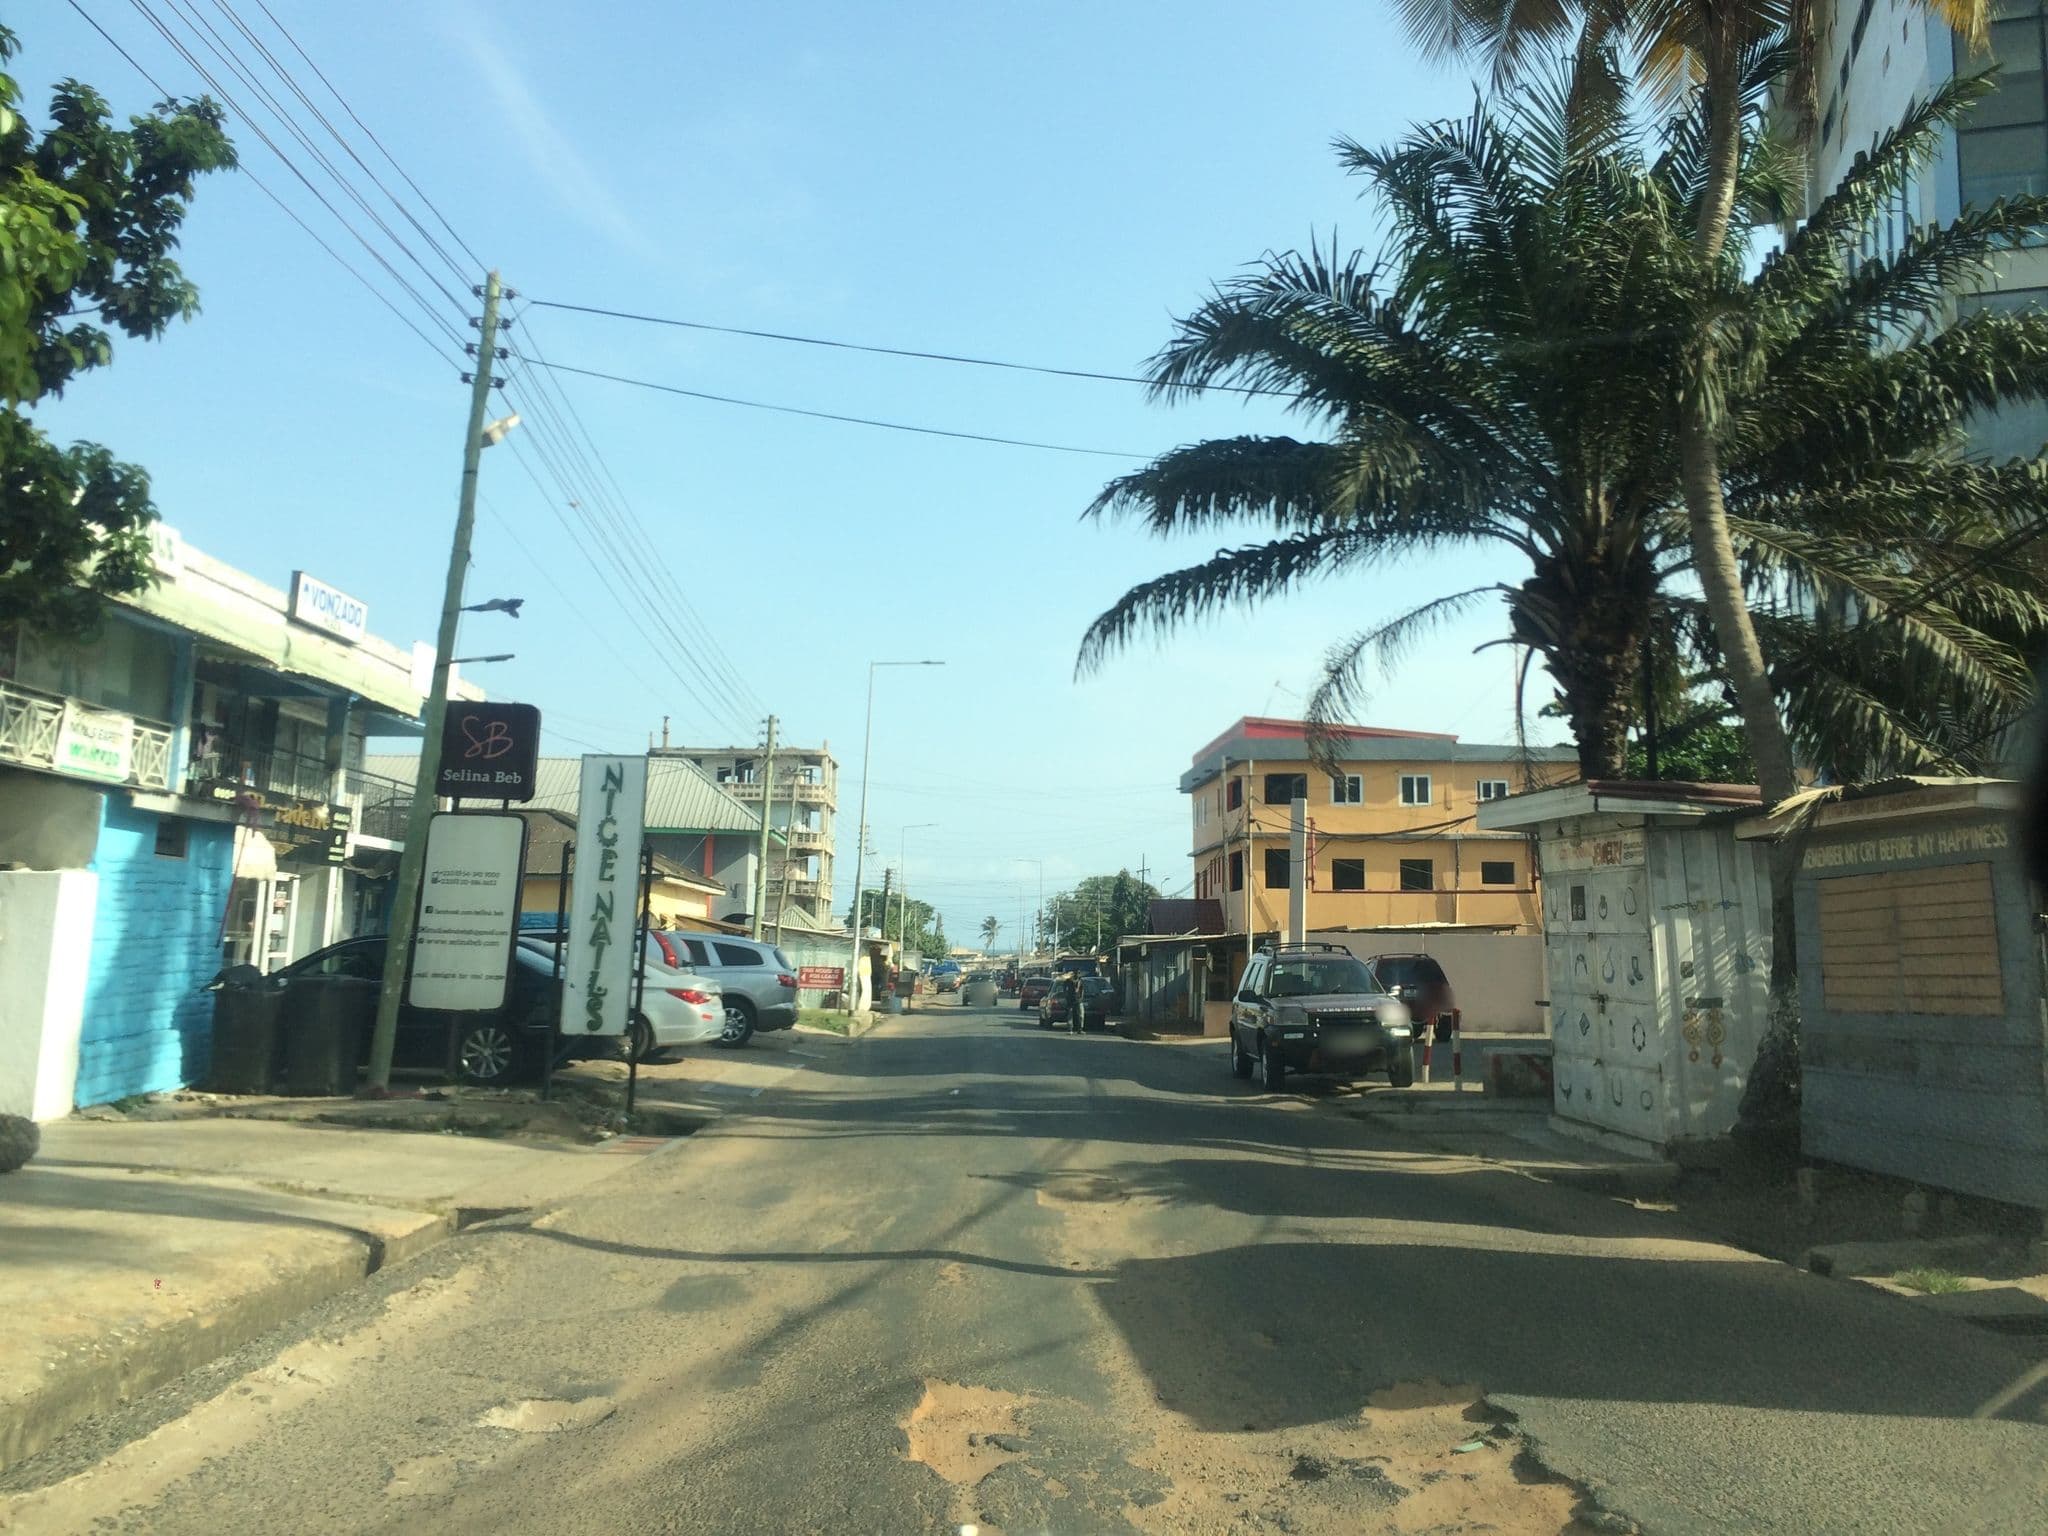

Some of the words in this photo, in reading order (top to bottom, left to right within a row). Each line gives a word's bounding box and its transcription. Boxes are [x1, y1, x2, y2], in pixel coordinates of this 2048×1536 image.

[462, 715, 514, 759] SB
[442, 769, 490, 782] Selina
[495, 771, 522, 784] Beb
[596, 761, 624, 882] NICE
[1845, 842, 1858, 865] MY
[1860, 840, 1876, 863] CRY
[1879, 835, 1915, 861] BEFORE
[1917, 832, 1935, 858] MY
[1938, 823, 2009, 854] HAPPINESS
[586, 889, 614, 1032] NAILS
